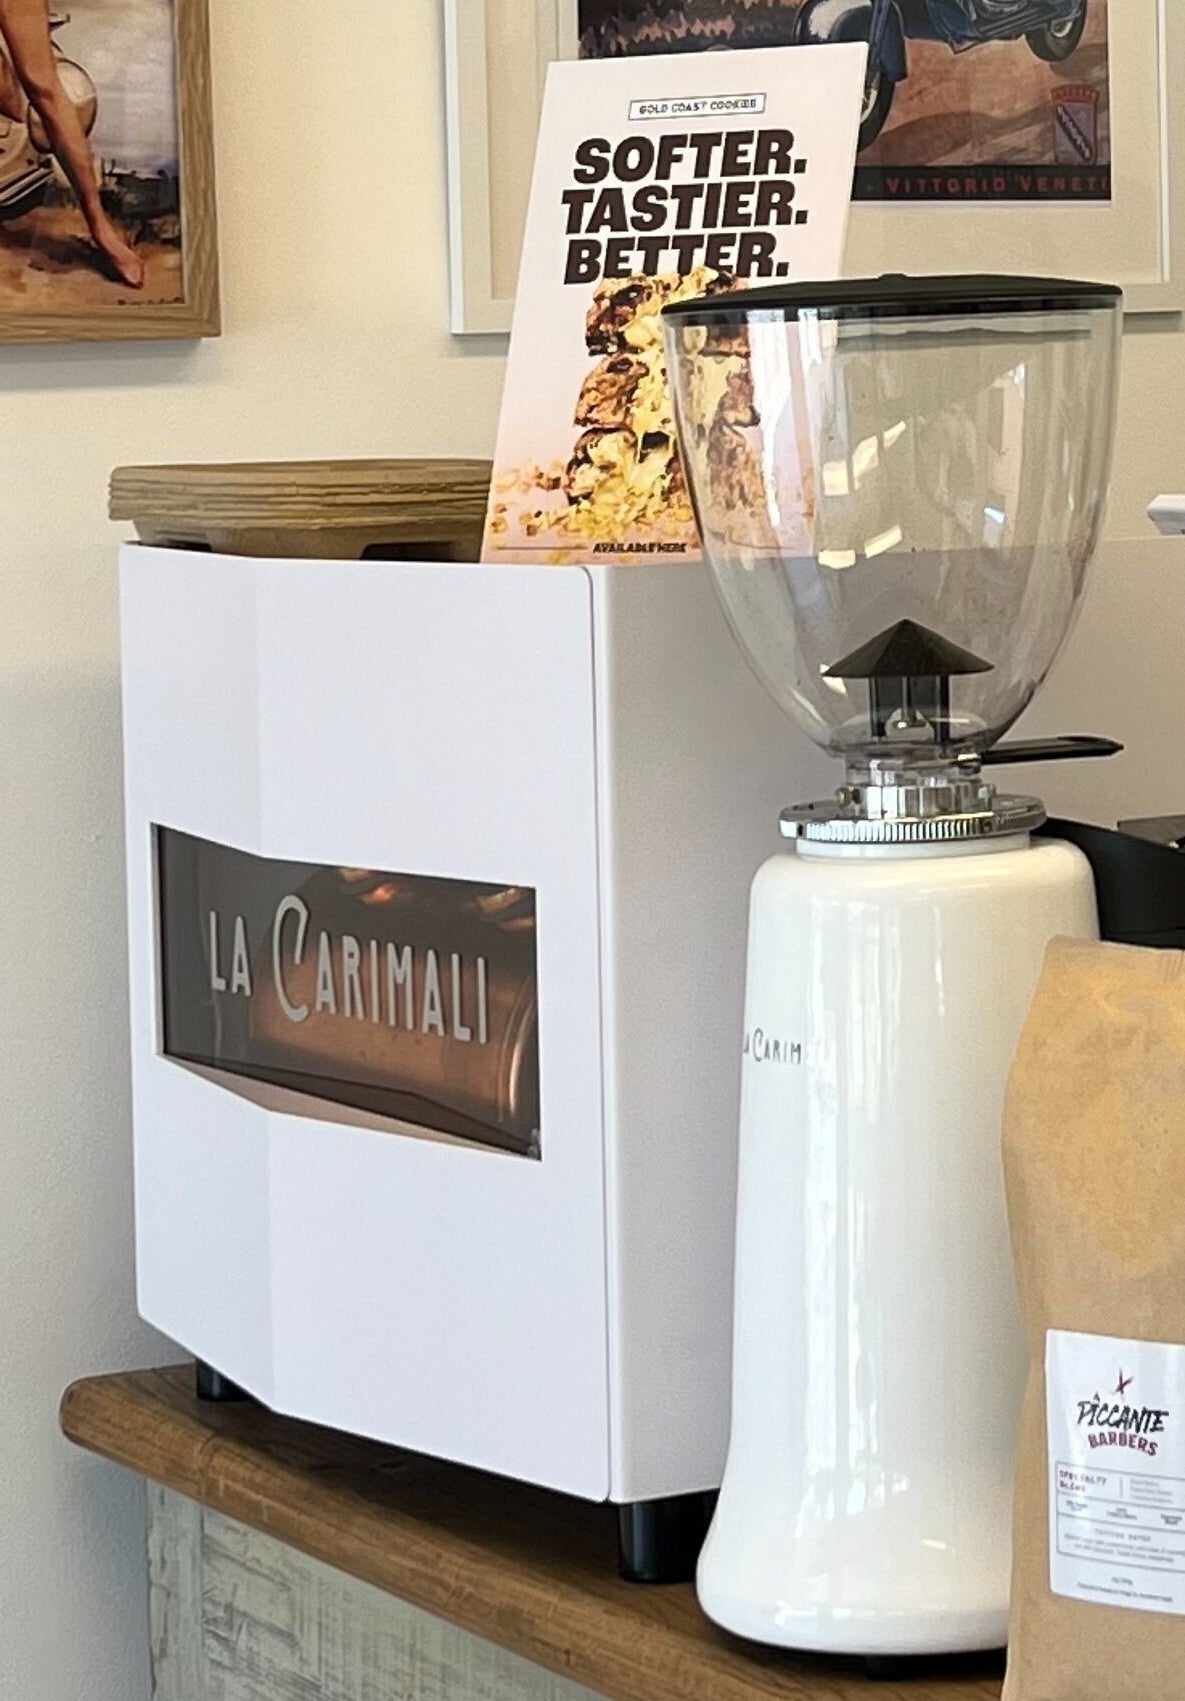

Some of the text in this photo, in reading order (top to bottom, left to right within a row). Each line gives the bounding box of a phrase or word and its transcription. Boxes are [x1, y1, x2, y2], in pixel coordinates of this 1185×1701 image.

[639, 98, 757, 114] GOLD COAST COOKIES
[573, 129, 807, 184] SOFTER.
[886, 177, 1006, 194] VITTORIO
[561, 180, 809, 235] TASTIER.
[564, 232, 789, 285] BETTER.
[209, 895, 487, 1045] LA CARIMALI
[752, 1027, 801, 1064] CARIM
[1077, 1392, 1169, 1434] PICCANTE
[1088, 1432, 1158, 1456] BARBERS
